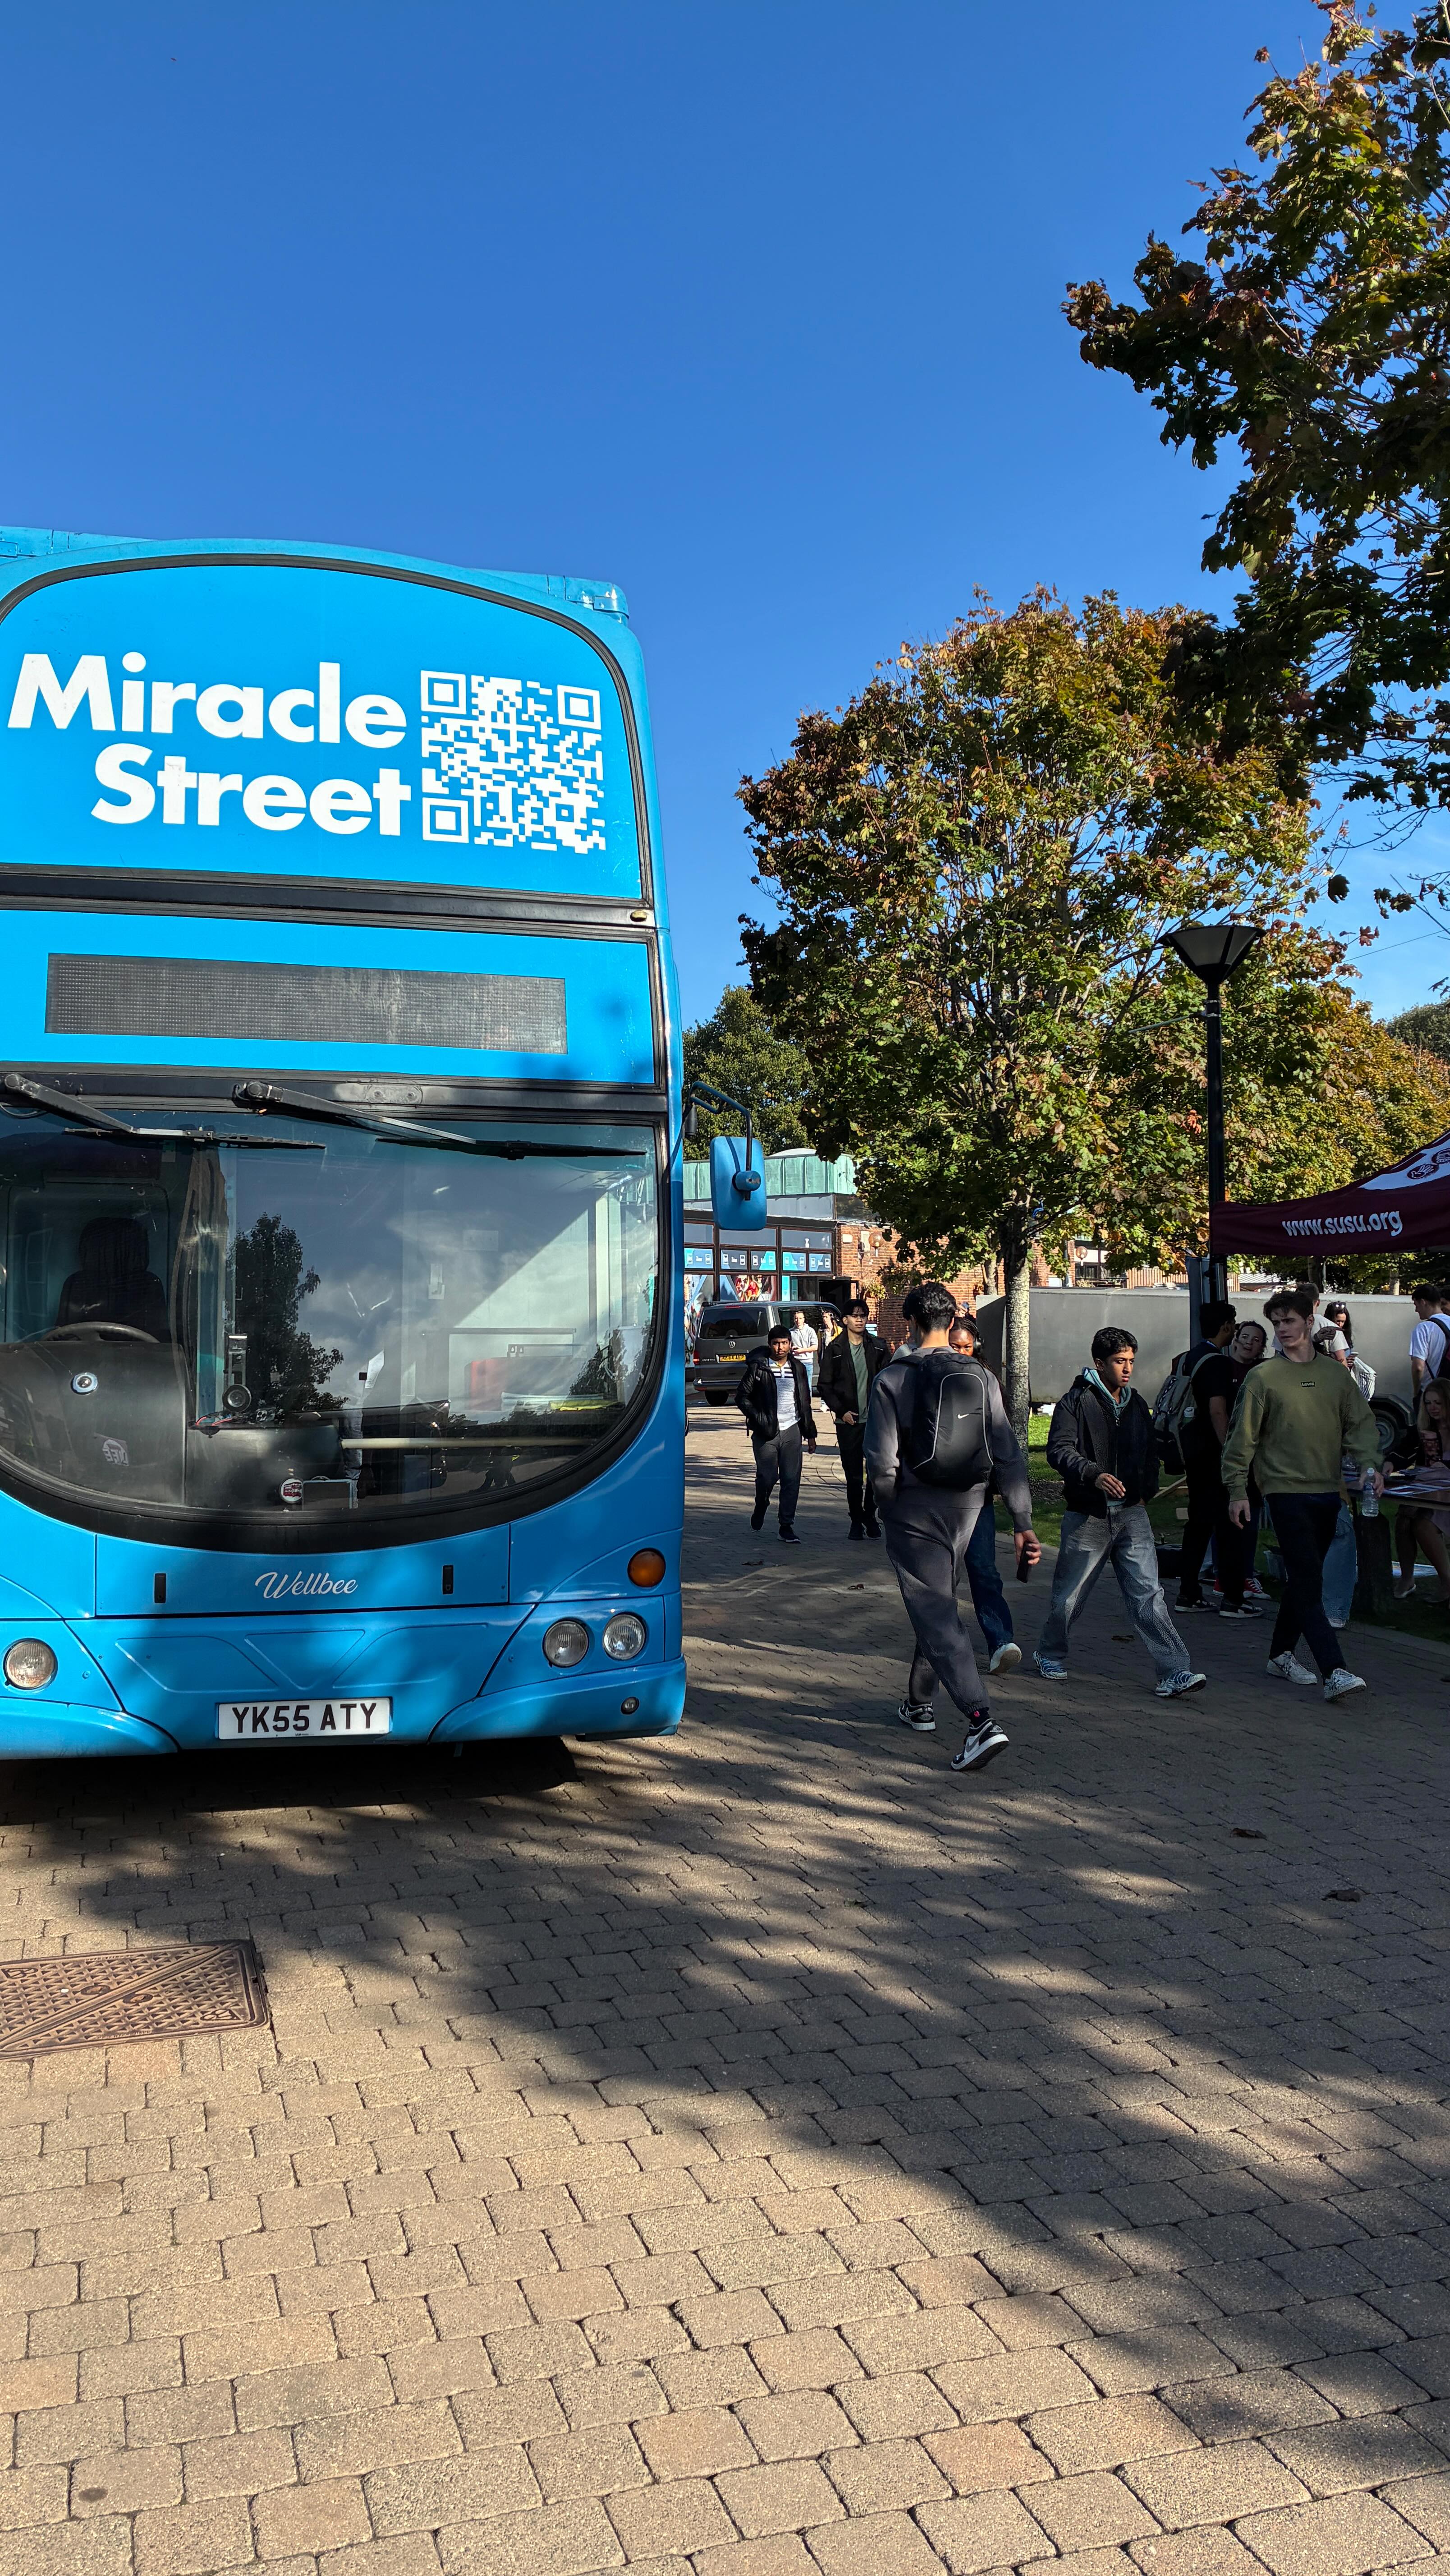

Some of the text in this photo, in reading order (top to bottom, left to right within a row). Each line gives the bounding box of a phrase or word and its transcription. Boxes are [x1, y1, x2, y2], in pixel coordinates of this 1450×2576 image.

[8, 652, 407, 749] Miracle
[91, 743, 411, 836] Street
[1282, 1211, 1403, 1237] www.susu.org
[255, 1571, 358, 1599] Wellbee
[232, 1702, 376, 1734] YK55 ATY
